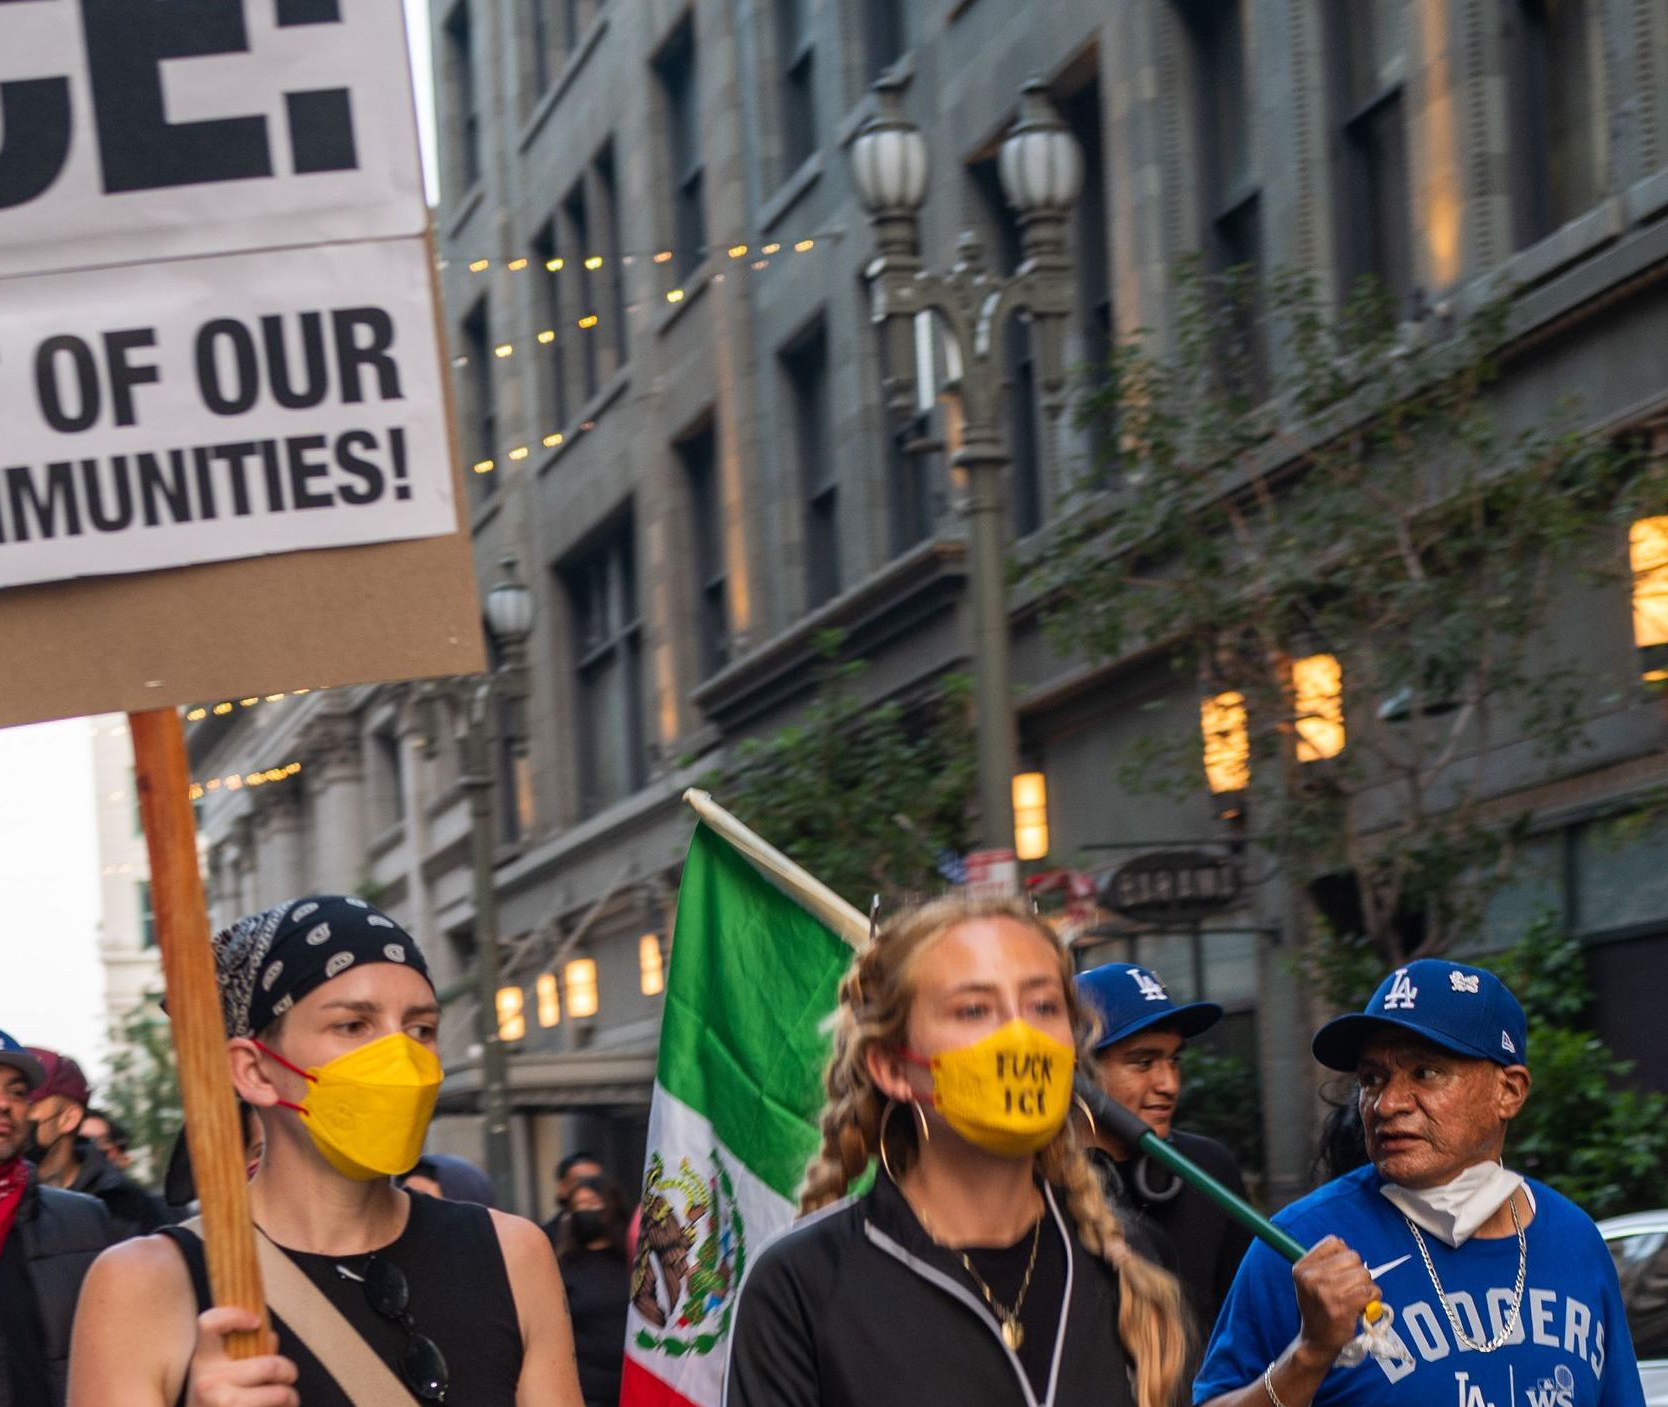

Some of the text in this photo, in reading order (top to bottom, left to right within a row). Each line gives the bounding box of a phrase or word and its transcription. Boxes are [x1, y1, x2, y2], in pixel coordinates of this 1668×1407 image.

[37, 327, 161, 434] OF
[196, 307, 405, 416] OUR
[1126, 968, 1169, 1001] LA
[1384, 967, 1418, 1010] LA
[997, 1052, 1053, 1085] FUCK
[1005, 1087, 1046, 1116] ICE
